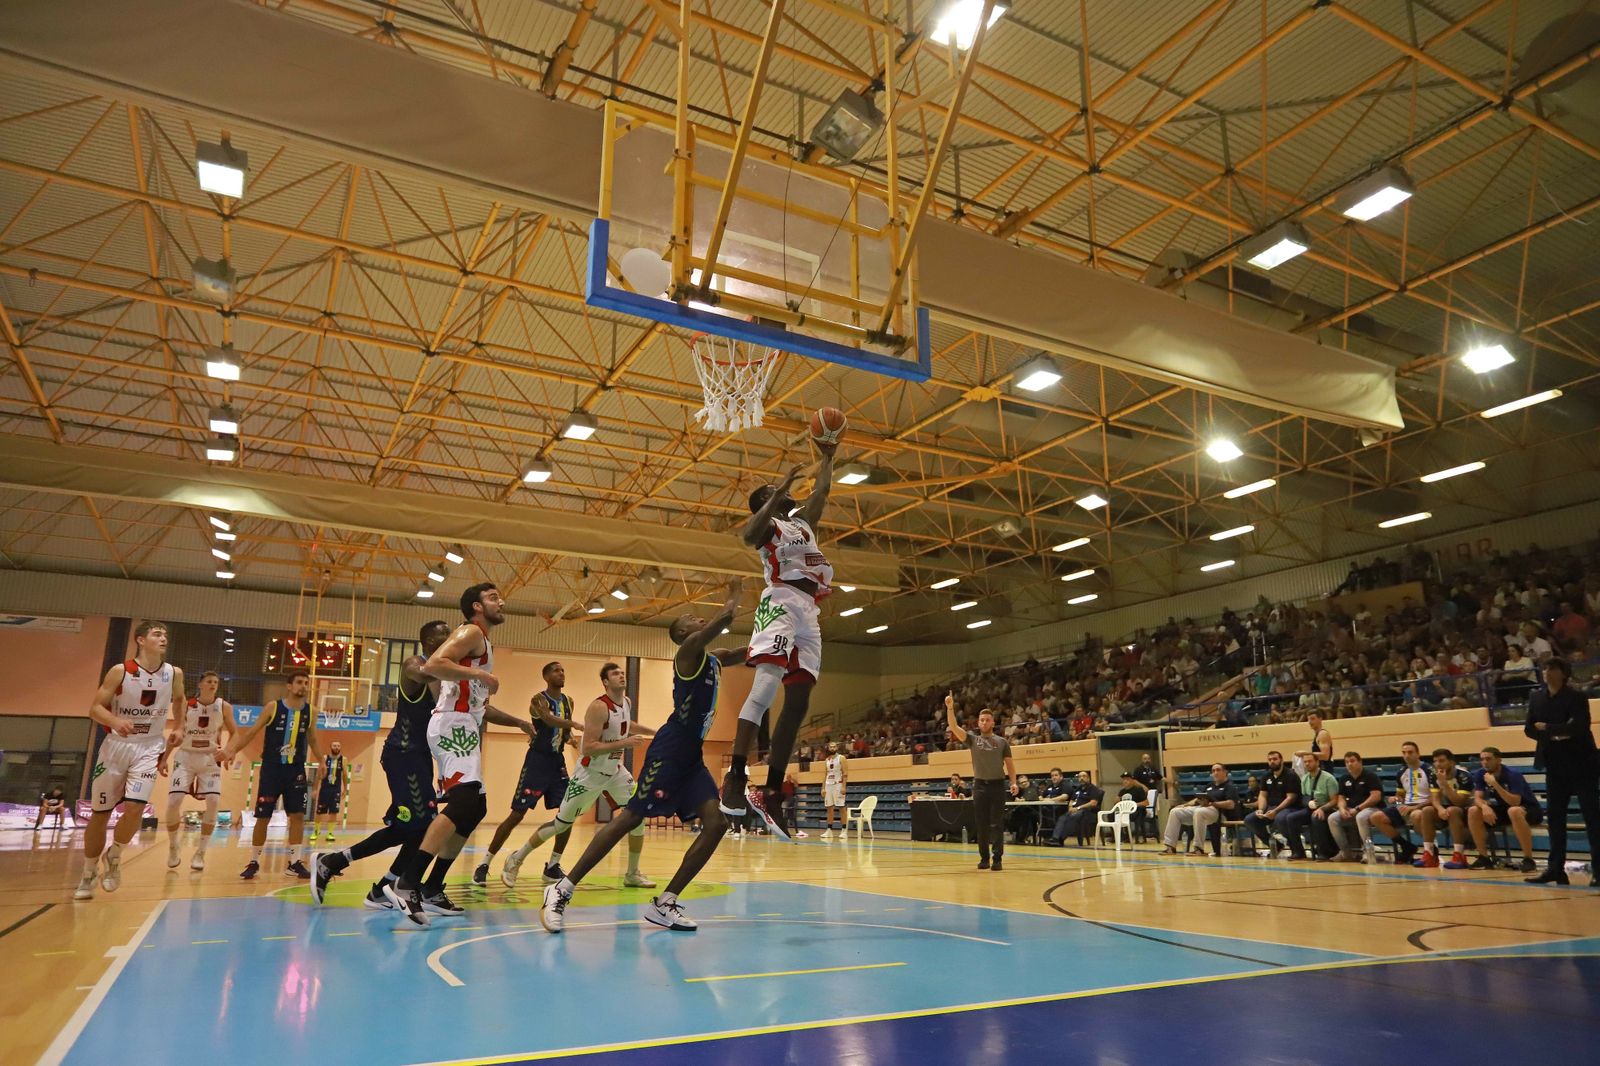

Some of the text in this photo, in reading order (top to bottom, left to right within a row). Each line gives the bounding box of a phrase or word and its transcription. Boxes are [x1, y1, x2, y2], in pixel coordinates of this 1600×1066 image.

[147, 678, 153, 688] 5
[173, 778, 181, 787] 14
[100, 792, 106, 805] 5
